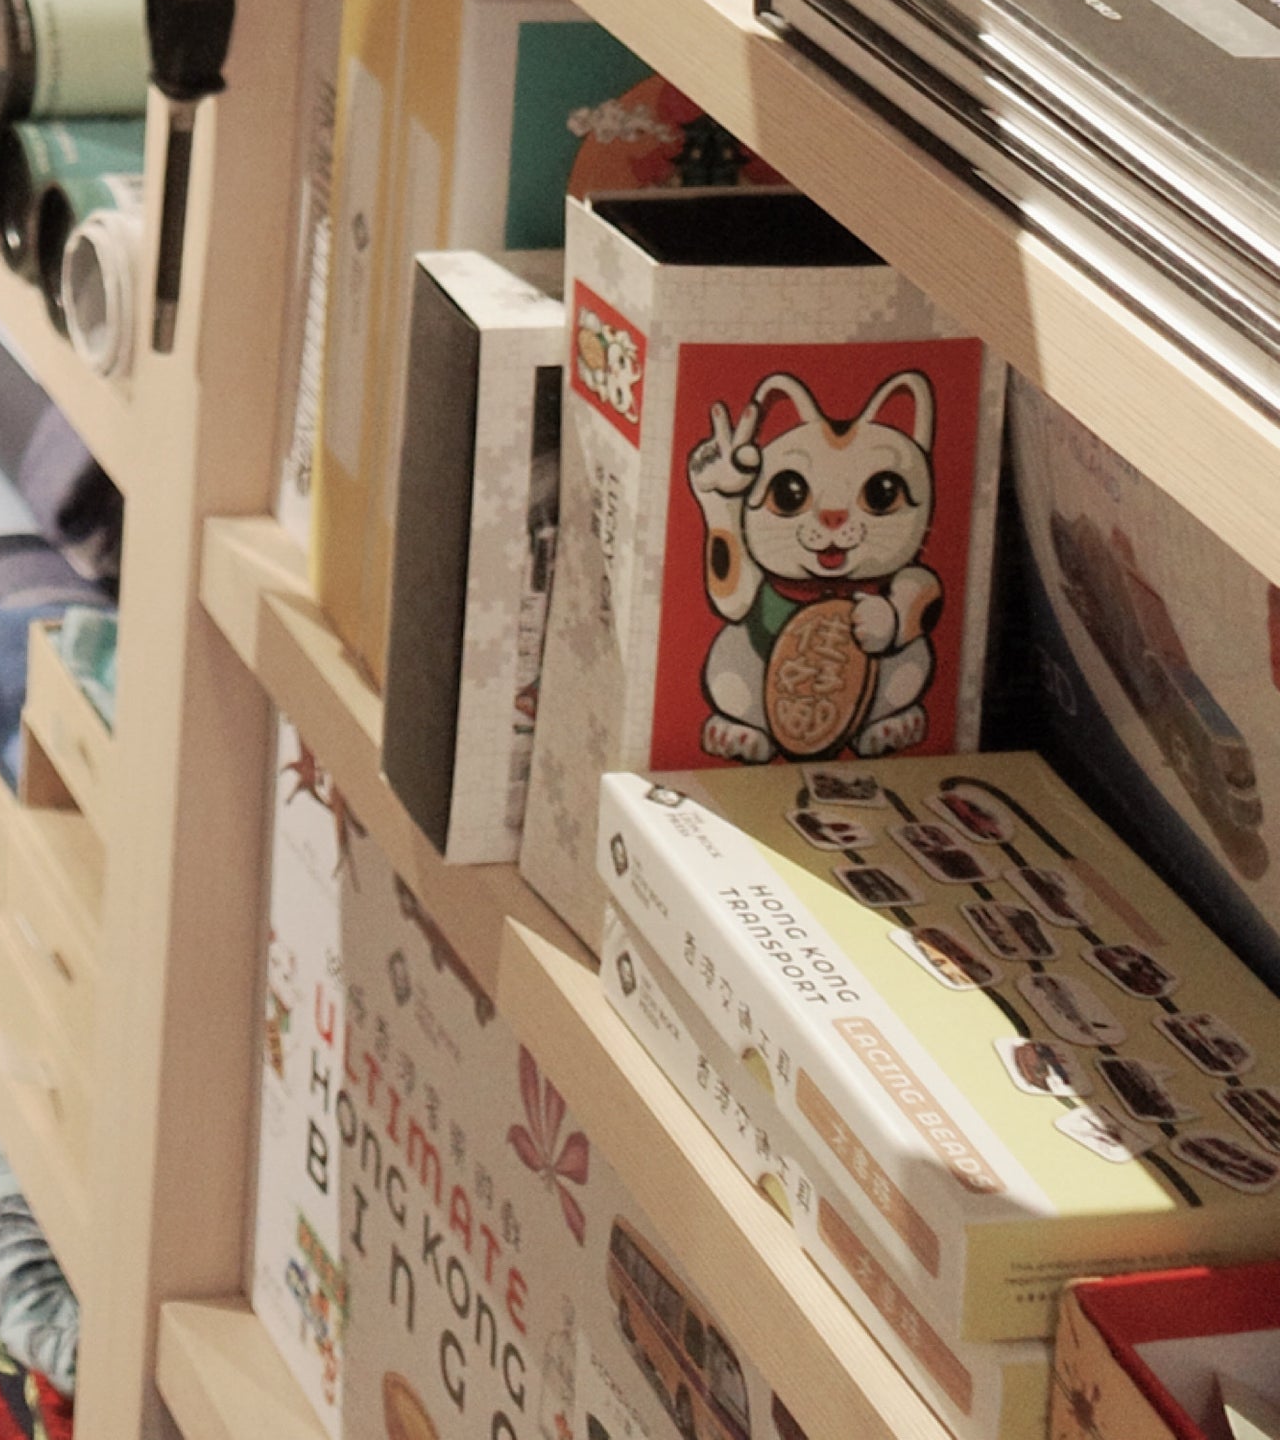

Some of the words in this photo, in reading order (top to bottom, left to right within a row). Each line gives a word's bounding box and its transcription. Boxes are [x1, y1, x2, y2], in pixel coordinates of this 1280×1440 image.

[718, 886, 830, 1006] TRANSPORT
[747, 883, 809, 942] HONG
[798, 945, 862, 1004] KONG
[915, 1110, 995, 1189] BEADS
